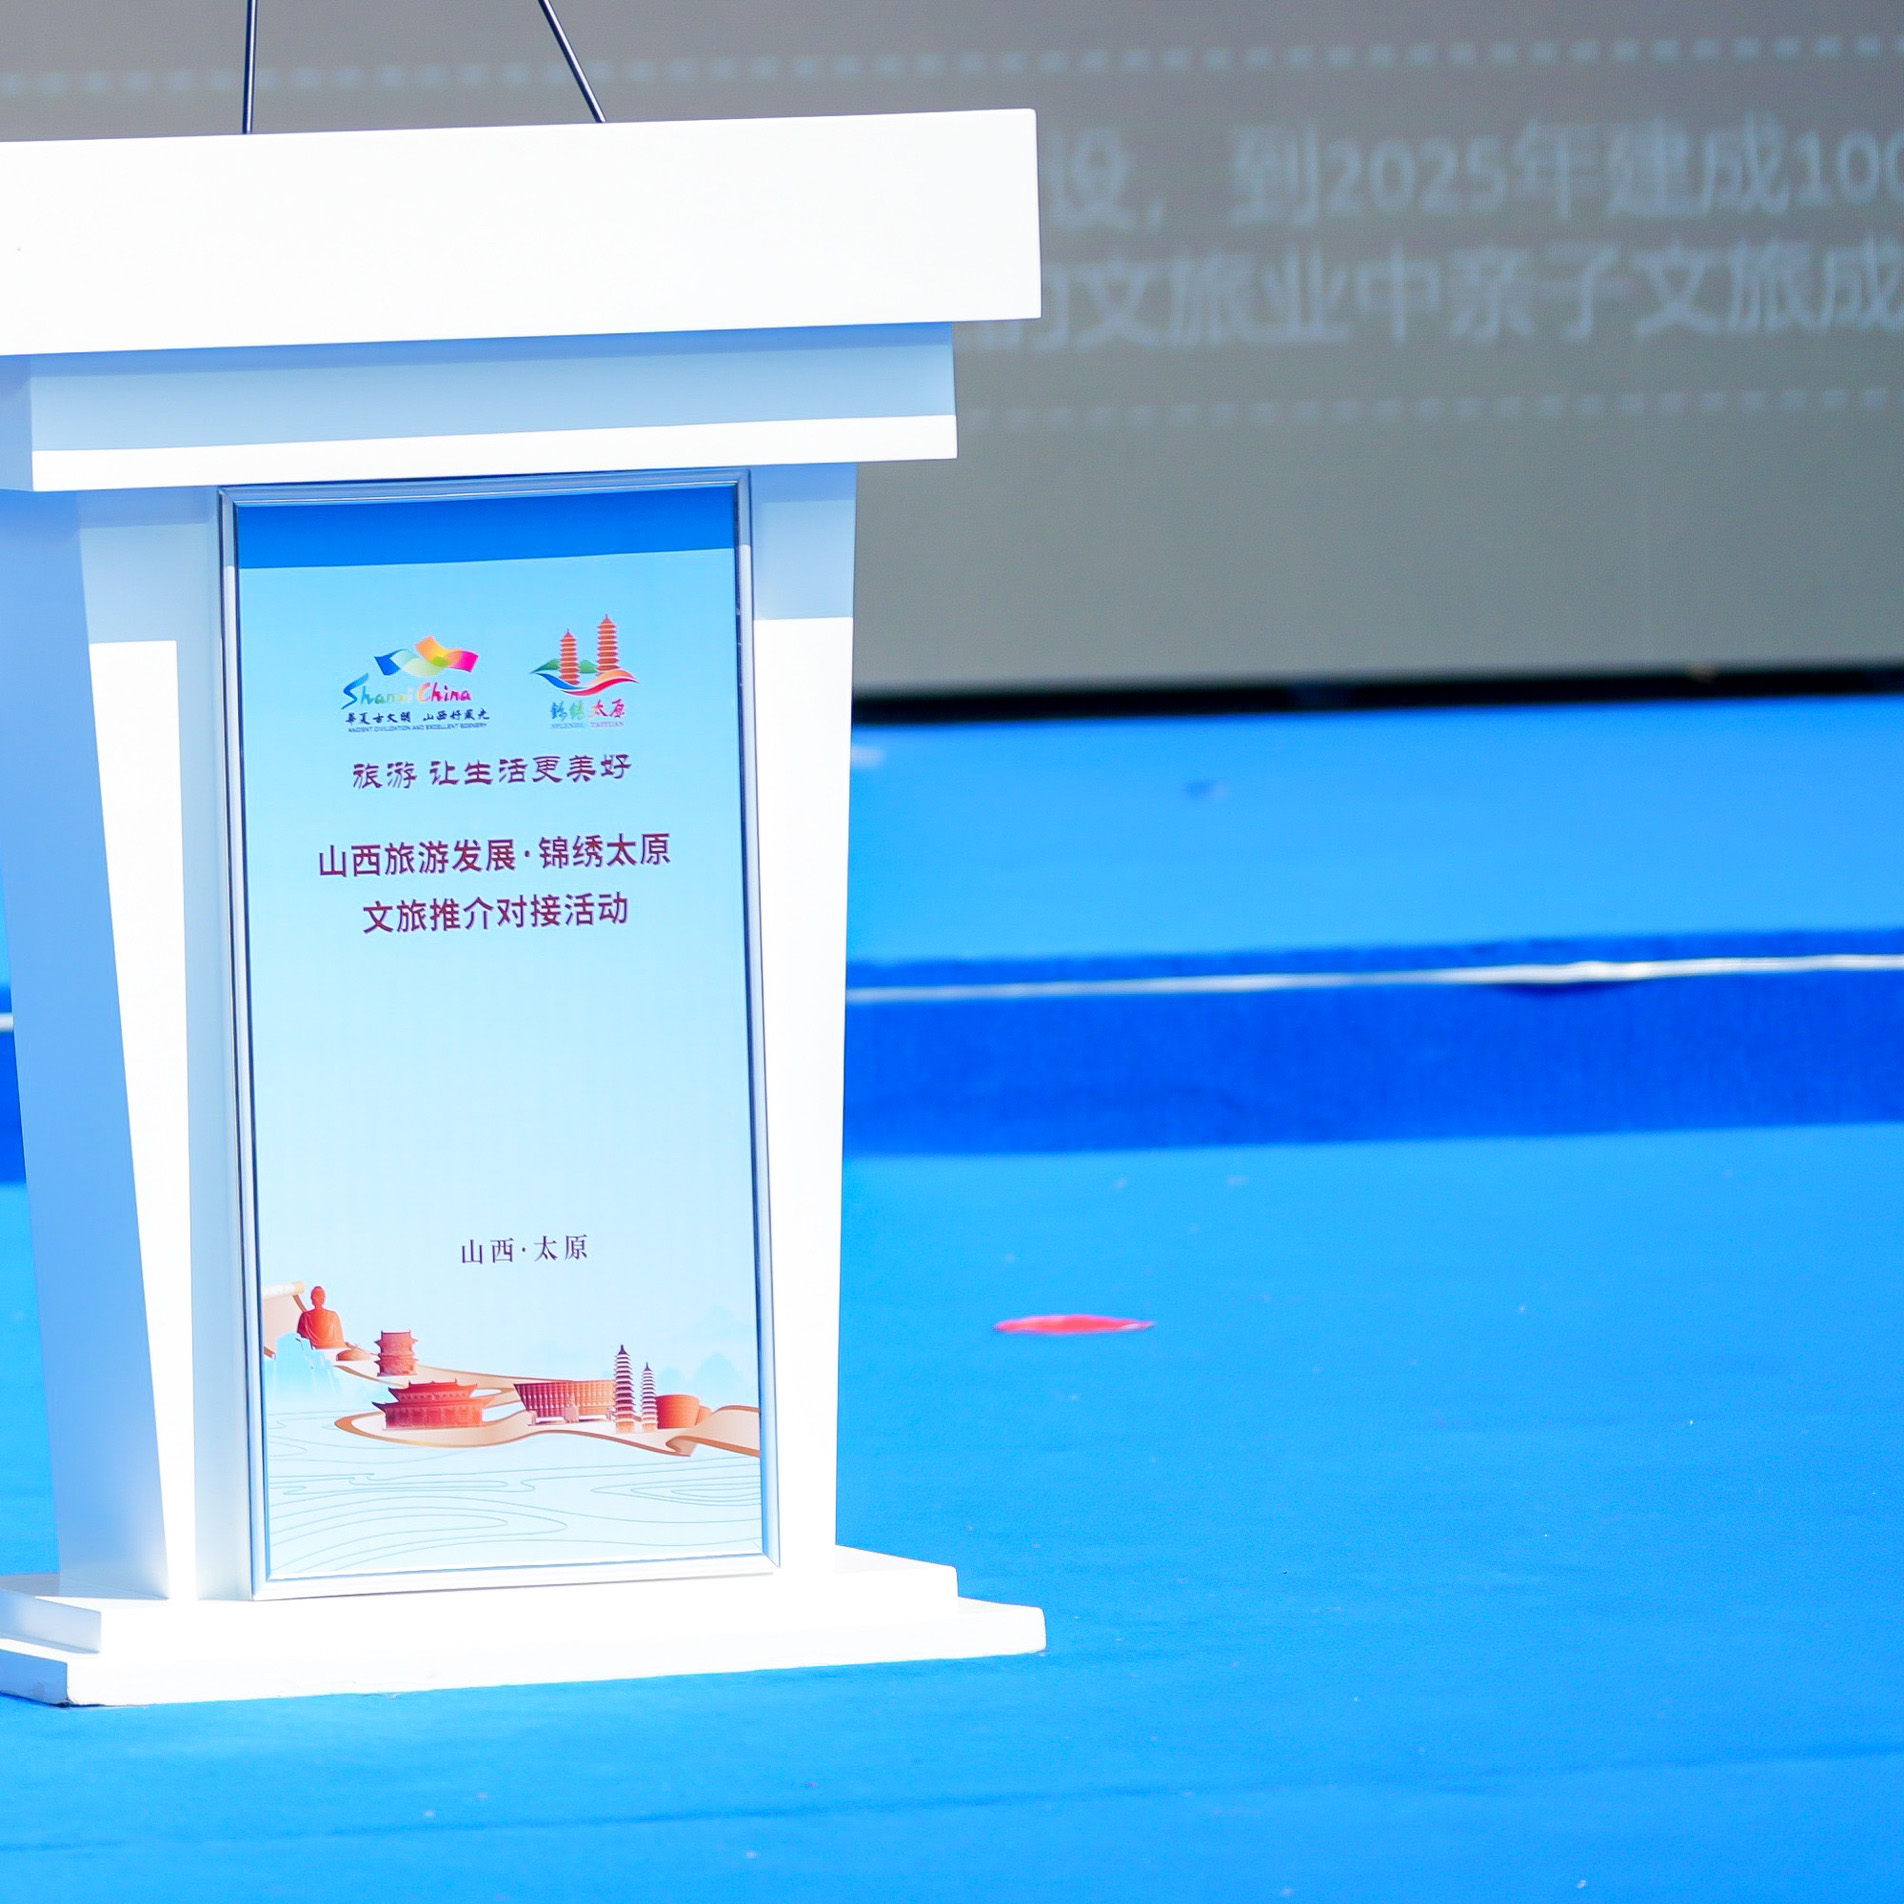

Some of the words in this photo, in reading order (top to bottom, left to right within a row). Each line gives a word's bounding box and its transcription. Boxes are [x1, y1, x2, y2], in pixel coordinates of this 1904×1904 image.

[341, 672, 413, 709] Shan
[417, 681, 471, 702] China
[352, 760, 417, 789] 旅游
[429, 753, 632, 785] 让生活更美好
[318, 832, 671, 878] 山西旅游发展·锦绣太原
[363, 891, 630, 934] 文旅推介对接活动
[460, 1233, 589, 1265] 山西·太原
